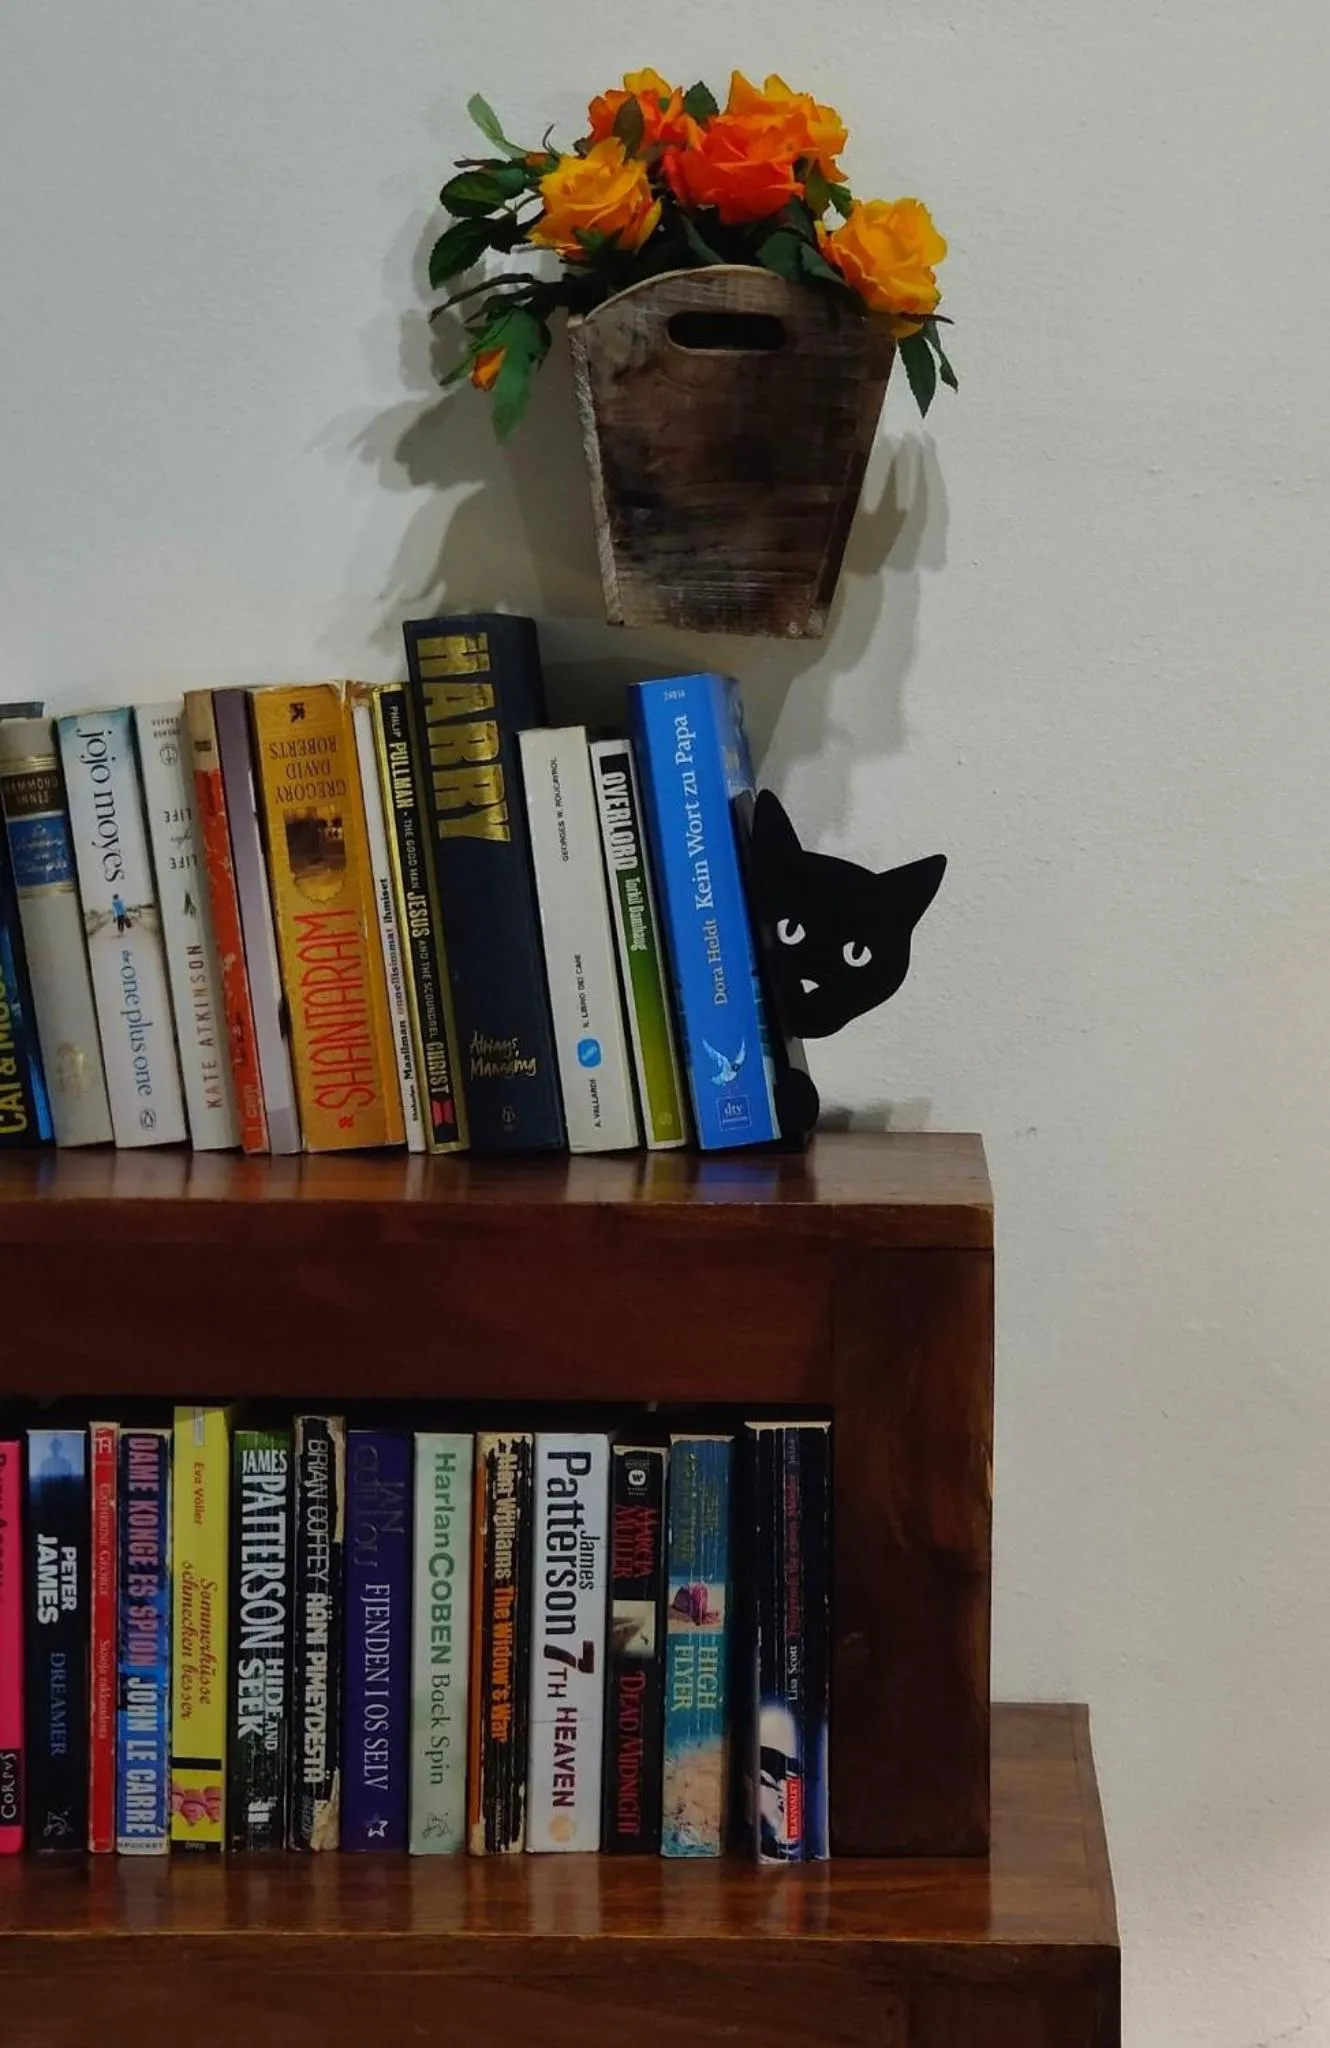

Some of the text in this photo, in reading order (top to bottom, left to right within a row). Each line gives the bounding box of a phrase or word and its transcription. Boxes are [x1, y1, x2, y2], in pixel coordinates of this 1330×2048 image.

[270, 735, 337, 760] ROBERTS
[286, 760, 331, 780] DAVID
[416, 631, 511, 842] HARRY
[77, 728, 125, 883] jojo moyes
[164, 808, 192, 823] LIFE
[275, 779, 347, 804] GREGORY
[601, 771, 638, 871] OVERLORD
[673, 713, 714, 911] Kein Wort zu Papa
[170, 855, 197, 870] LIFE
[556, 819, 569, 862] GEORGES
[389, 705, 449, 1094] PHILIP PULLMAN THE GOOD MAN JESUS AND THE SCOUNDREL CHRIST
[625, 878, 644, 907] Torkil
[120, 965, 139, 1006] one
[703, 918, 728, 1005] Dora Heldt
[120, 1008, 153, 1054] plus
[187, 945, 223, 1109] KATE ATKINSON
[294, 909, 376, 1110] SHANTARAM
[133, 1055, 152, 1096] one
[399, 1020, 413, 1080] Maailman
[589, 1079, 601, 1118] VALLARDI
[724, 1103, 743, 1116] dtv
[193, 1462, 206, 1526] Eva Völler
[242, 1449, 288, 1474] JAMES
[303, 1439, 331, 1582] BRIAN COFFEY
[378, 1480, 405, 1534] JAN
[494, 1498, 517, 1579] Williams
[545, 1452, 592, 1635] Patterson
[612, 1505, 635, 1578] MULLER
[634, 1505, 660, 1577] MARCIA
[37, 1533, 58, 1625] JAMES
[61, 1546, 77, 1611] PETER
[128, 1438, 160, 1667] DAME KONGE ES SPION
[240, 1475, 286, 1649] PATTERSON
[428, 1453, 456, 1664] Harlan COBEN
[579, 1530, 600, 1590] James
[180, 1560, 199, 1720] schmecken besser
[198, 1577, 217, 1704] Sommerküsse
[306, 1592, 333, 1645] ÄÄNI
[360, 1584, 390, 1682] FJENDEN
[491, 1585, 515, 1744] The Widow's War
[671, 1644, 695, 1712] FLYER
[698, 1645, 720, 1709] HIGH
[788, 1645, 799, 1674] Scott
[788, 1676, 799, 1701] Lisa
[51, 1652, 68, 1756] DREAMER
[237, 1658, 265, 1739] SEEK
[264, 1658, 284, 1751] HIDE AND
[303, 1651, 331, 1783] PIMEYDESTÄ
[364, 1704, 389, 1732] OS
[425, 1674, 451, 1785] Back Spin
[126, 1676, 165, 1834] JOHN LE CARRÉ
[364, 1738, 389, 1790] SELV
[552, 1707, 578, 1808] HEAVEN
[617, 1670, 646, 1836] DEAD MIDNIGHT
